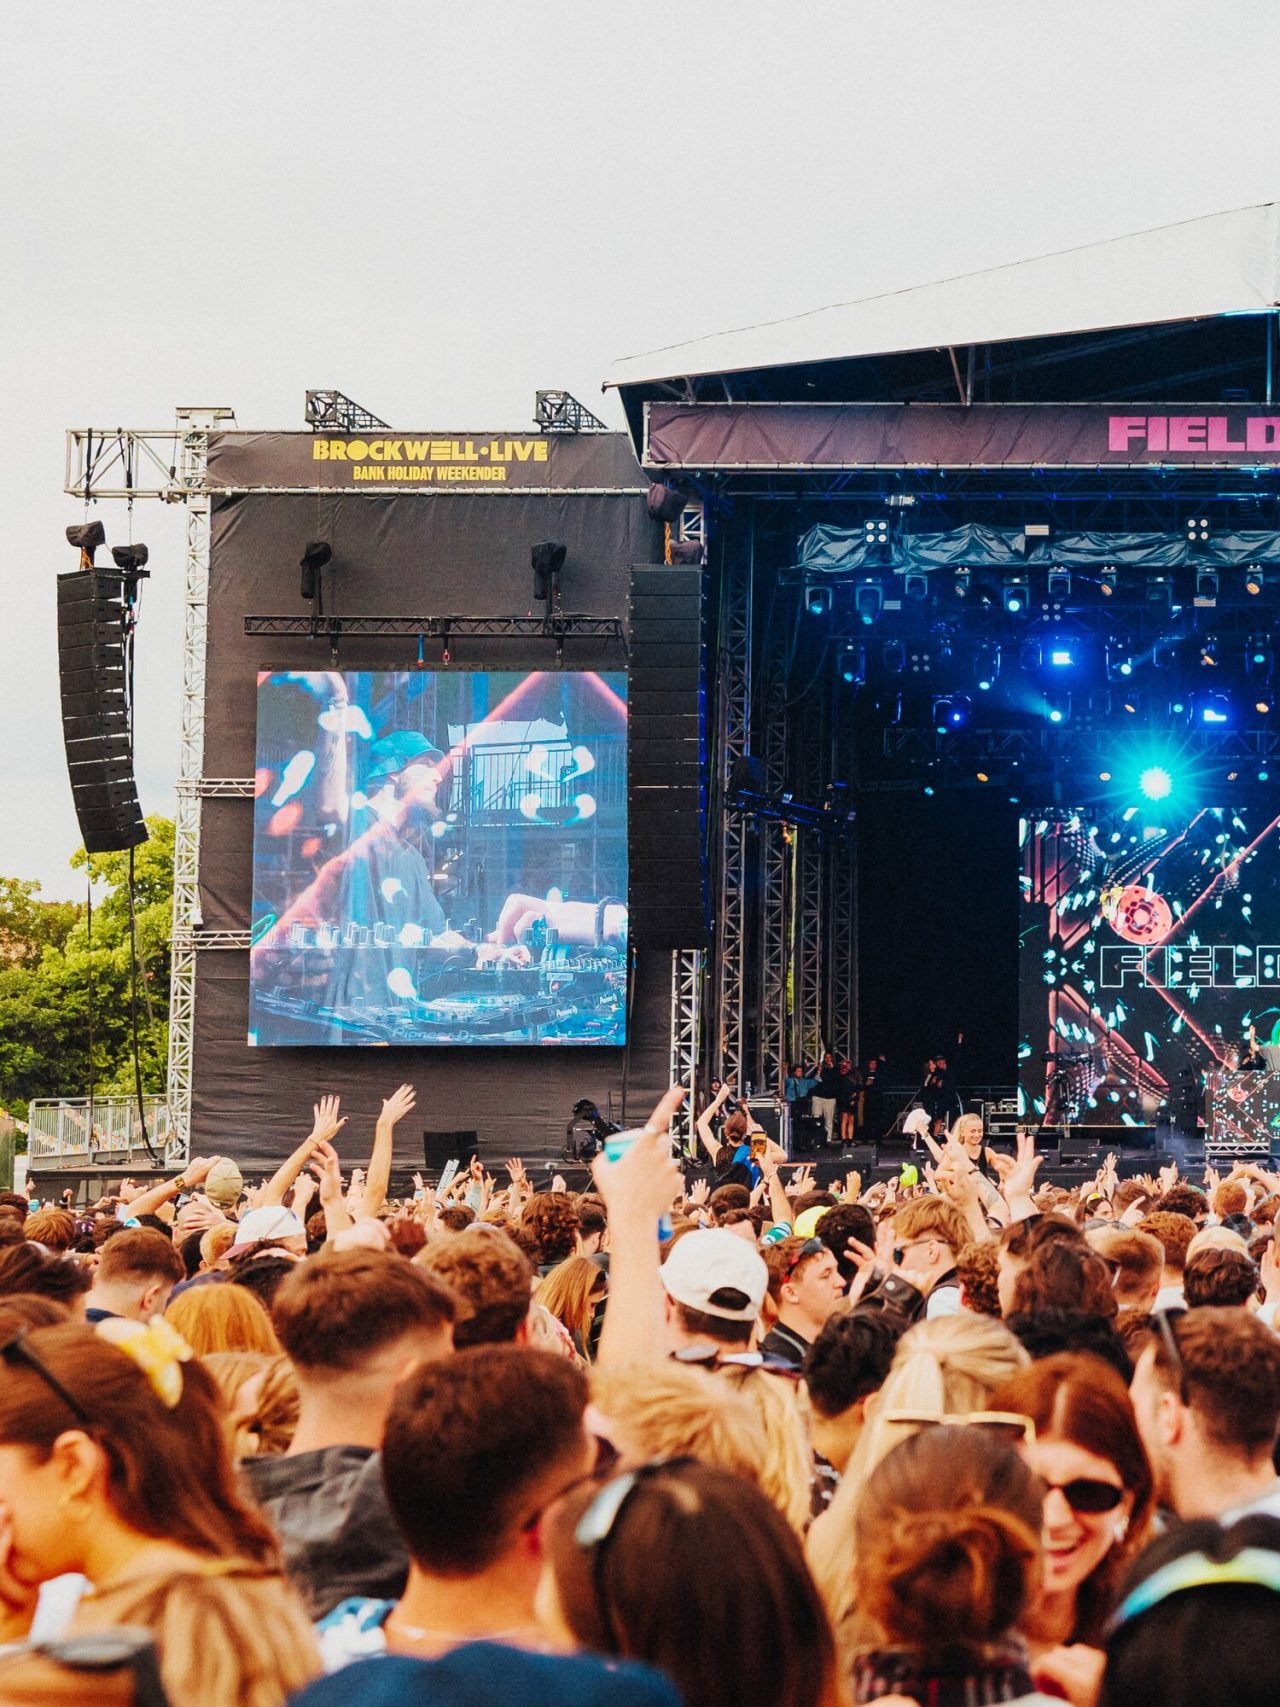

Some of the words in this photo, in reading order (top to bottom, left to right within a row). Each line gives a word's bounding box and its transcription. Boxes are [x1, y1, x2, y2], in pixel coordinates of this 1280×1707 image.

[353, 466, 385, 481] BANK
[387, 466, 433, 481] HOLIDAY
[437, 466, 506, 481] WEEKENDER
